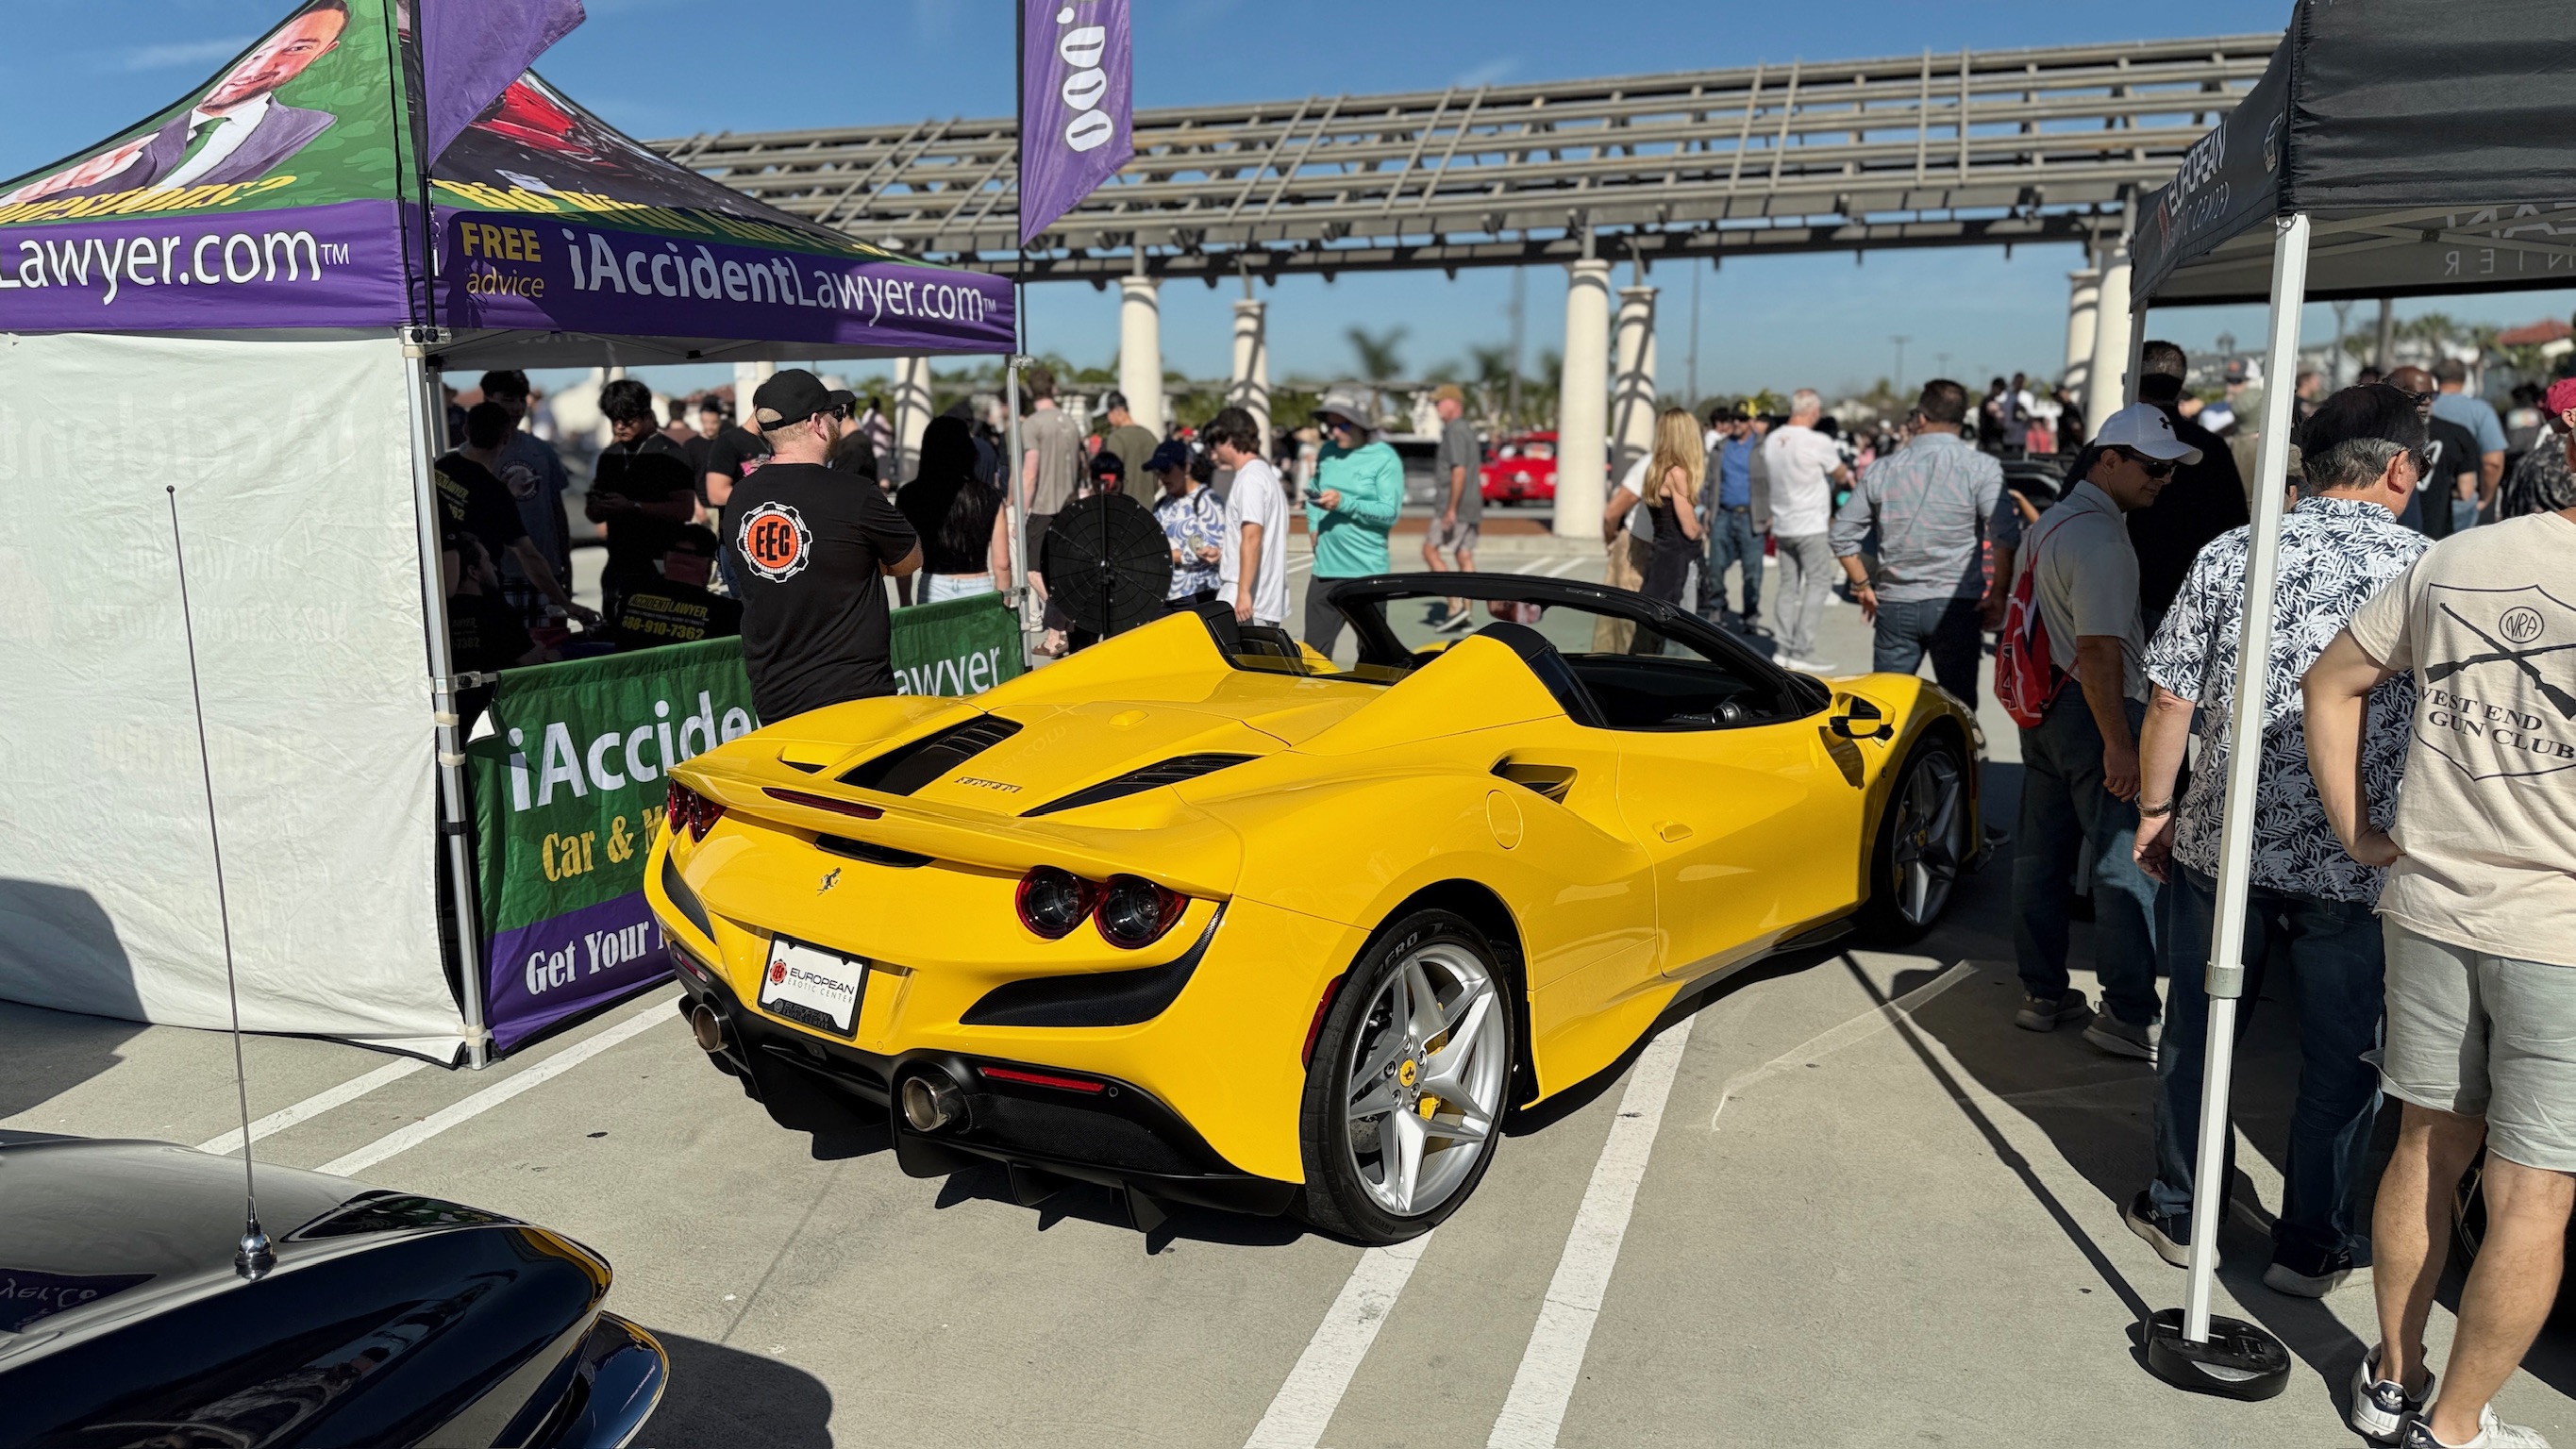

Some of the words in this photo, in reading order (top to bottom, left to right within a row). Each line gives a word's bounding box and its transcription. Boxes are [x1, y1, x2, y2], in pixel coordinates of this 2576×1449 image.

[2167, 119, 2228, 218] EUROPEAN
[0, 175, 298, 225] uestions?
[460, 222, 542, 263] FREE
[0, 230, 321, 306] awyer.com
[466, 266, 544, 298] advice
[756, 521, 791, 561] EEC
[2505, 612, 2538, 639] NRA
[2428, 710, 2486, 738] GUN
[2492, 728, 2575, 758] CLUB
[2484, 707, 2543, 731] END
[508, 691, 762, 812] iAccide
[954, 776, 1024, 794] Ferrari
[542, 830, 595, 882] Car
[608, 815, 634, 864] &
[526, 940, 577, 995] Get
[584, 920, 649, 974] Your
[787, 978, 816, 993] EXOTIC
[820, 988, 853, 1005] CENTER
[790, 967, 855, 995] EUROPEAN
